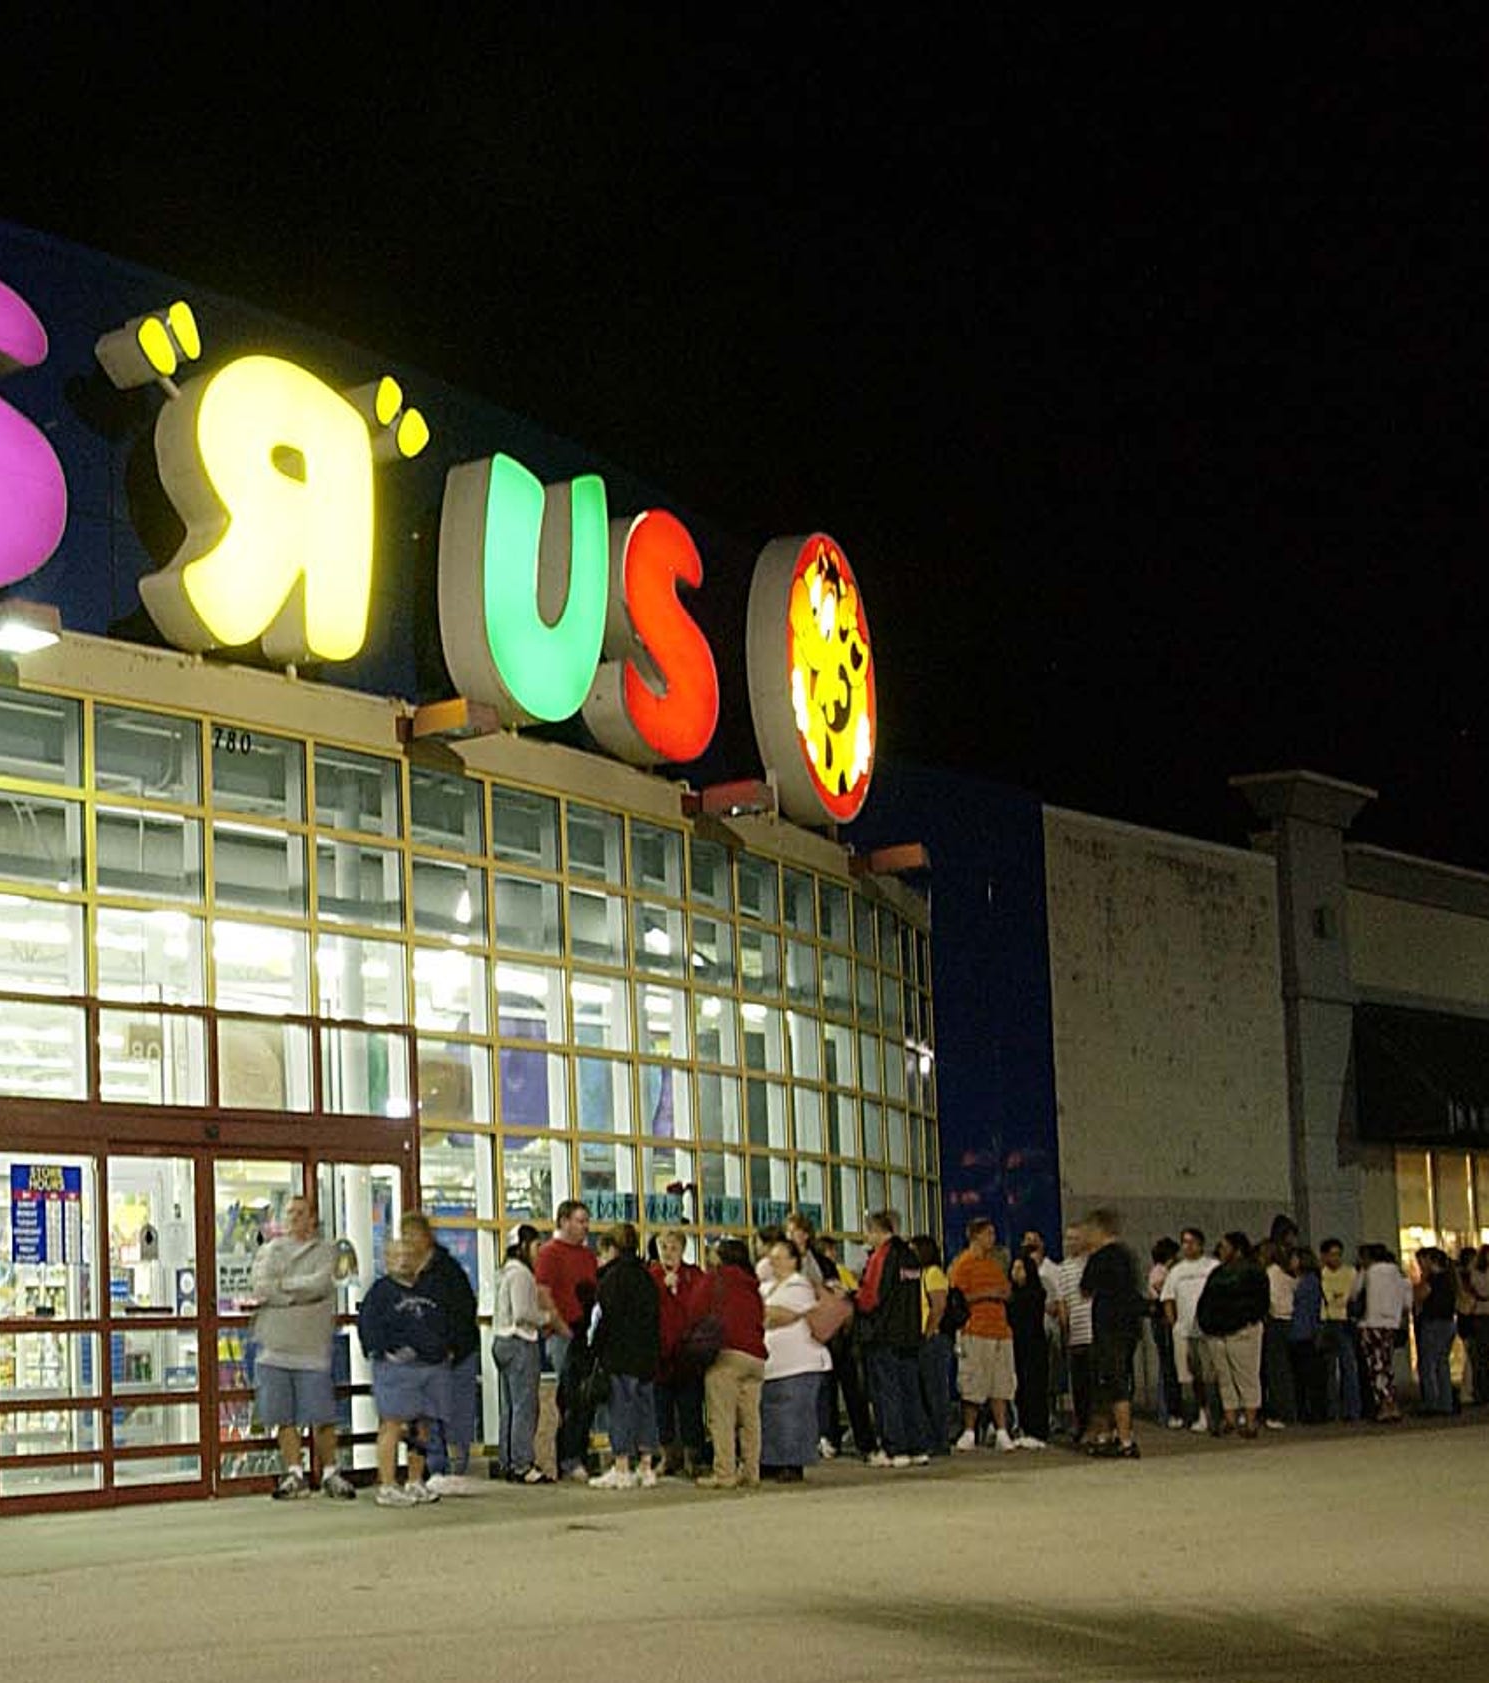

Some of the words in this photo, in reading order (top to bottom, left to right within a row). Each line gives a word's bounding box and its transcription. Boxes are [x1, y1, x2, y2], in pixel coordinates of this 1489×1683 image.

[481, 452, 720, 764] US
[214, 727, 252, 756] 780
[29, 1178, 65, 1191] HOURS
